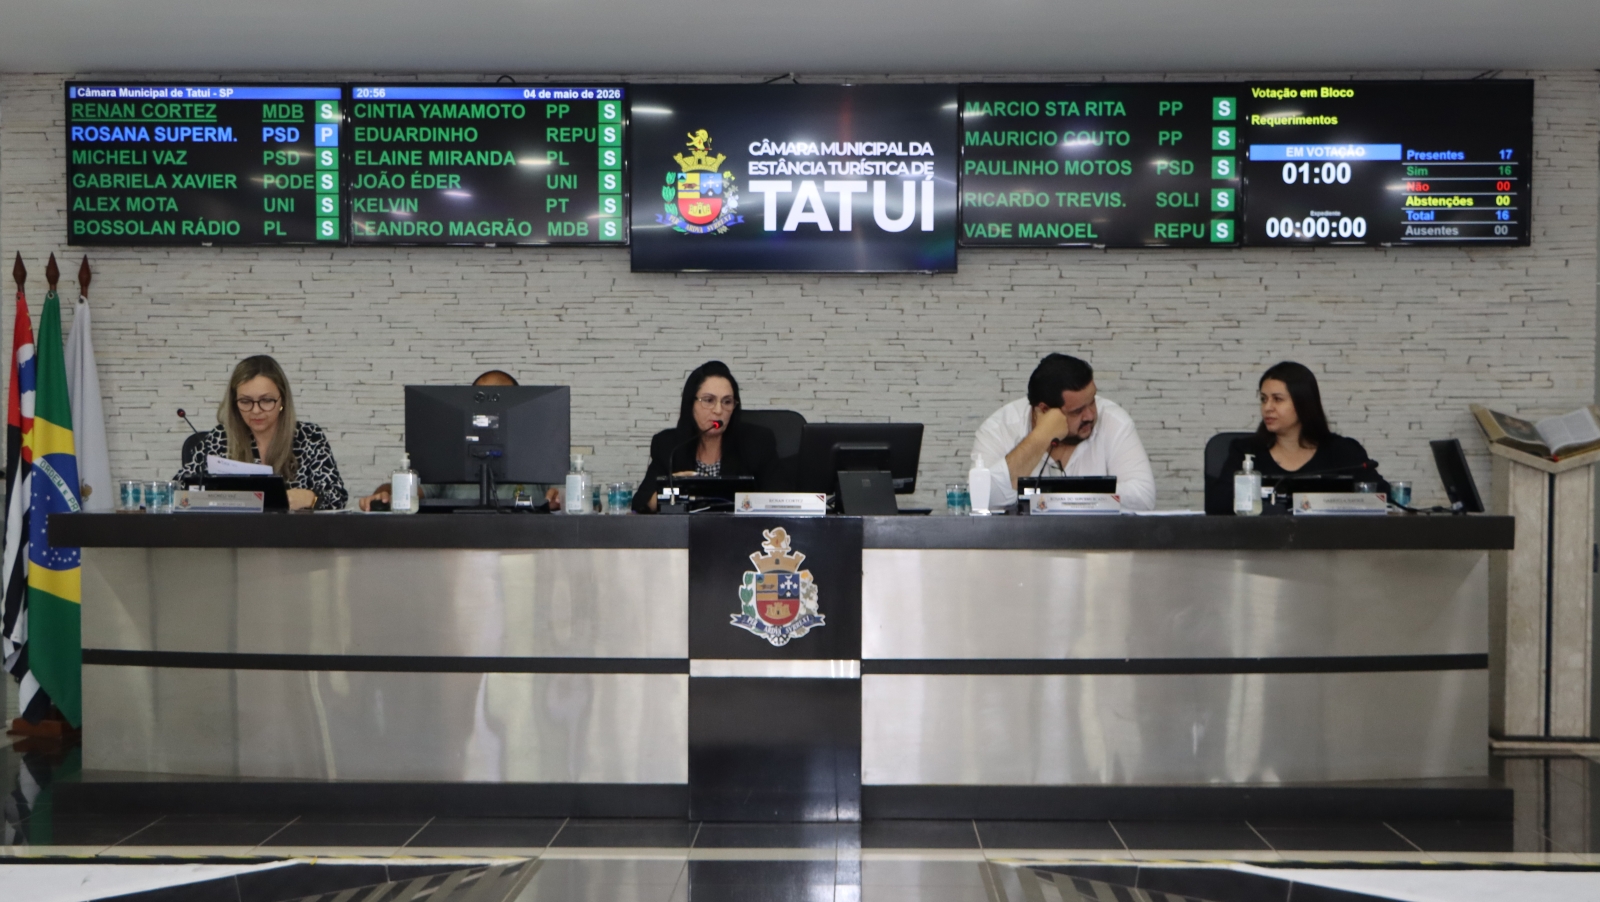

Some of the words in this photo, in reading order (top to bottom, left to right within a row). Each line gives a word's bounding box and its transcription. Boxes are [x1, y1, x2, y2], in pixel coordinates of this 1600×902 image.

[77, 88, 117, 98] Câmara
[119, 88, 168, 99] Municipal
[170, 88, 183, 98] de
[219, 89, 233, 98] SP
[356, 89, 385, 98] 20:56
[524, 90, 536, 98] 04
[539, 89, 551, 98] de
[554, 90, 576, 98] maio
[579, 90, 592, 99] de
[596, 90, 620, 99] 2026
[1251, 88, 1297, 99] Votação
[1300, 89, 1317, 98] em
[1321, 88, 1354, 98] Bloco
[72, 104, 135, 118] RENAN
[141, 104, 217, 118] CORTEZ
[262, 104, 304, 119] MDB
[321, 104, 333, 119] S
[354, 104, 415, 118] CINTIA
[419, 104, 526, 119] YAMAMOTO
[546, 104, 570, 118] PP
[604, 104, 616, 119] S
[965, 102, 1040, 116] MARCIO
[1045, 102, 1080, 116] STA
[1085, 102, 1126, 116] RITA
[1159, 102, 1183, 115] PP
[1218, 101, 1230, 116] S
[1251, 115, 1337, 126] Requerimentos
[72, 127, 150, 141] ROSANA
[155, 127, 237, 141] SUPERM.
[262, 128, 299, 142] PSD
[321, 128, 333, 142] P
[355, 127, 478, 142] EDUARDINHO
[546, 128, 595, 142] REPU
[604, 128, 616, 142] S
[965, 132, 1057, 146] MAURICIO
[1063, 131, 1130, 146] COUTO
[1159, 132, 1182, 145] PP
[1218, 130, 1230, 145] S
[749, 138, 820, 156] CÂMARA
[821, 142, 908, 156] MUNICIPAL
[909, 142, 934, 156] DA
[1286, 147, 1303, 157] EM
[1306, 145, 1365, 159] VOTAÇÃO
[72, 151, 147, 165] MICHELI
[153, 151, 187, 165] VAZ
[263, 151, 300, 165] PSD
[321, 151, 333, 166] S
[355, 151, 422, 165] ELAINE
[429, 151, 516, 165] MIRANDA
[547, 151, 569, 165] PL
[604, 151, 616, 166] S
[1407, 150, 1465, 160] Presentes
[1500, 150, 1512, 160] 17
[749, 158, 826, 175] ESTÂNCIA
[828, 157, 907, 175] TURÍSTICA
[911, 162, 934, 175] DE
[965, 161, 1059, 175] PAULINHO
[1065, 160, 1132, 175] MOTOS
[1157, 161, 1194, 175] PSD
[1217, 160, 1229, 175] S
[1282, 163, 1351, 184] 01:00
[1407, 167, 1428, 175] Sim
[1499, 167, 1512, 175] 16
[72, 174, 167, 188] GABRIELA
[172, 174, 237, 188] XAVIER
[263, 175, 314, 189] PODE
[321, 175, 333, 189] S
[354, 171, 405, 189] JOÃO
[411, 171, 461, 189] ÉDER
[547, 175, 577, 189] UNI
[604, 175, 616, 189] S
[1406, 182, 1429, 191] Não
[1497, 182, 1510, 191] 00
[73, 197, 120, 212] ALEX
[127, 197, 178, 212] MOTA
[264, 198, 294, 212] UNI
[322, 198, 333, 212] S
[354, 198, 418, 212] KELVIN
[546, 198, 569, 212] PT
[604, 198, 616, 213] S
[749, 173, 934, 232] TATUÍ
[965, 193, 1050, 207] RICARDO
[1055, 193, 1126, 207] TREVIS.
[1156, 193, 1198, 207] SOLI
[1217, 192, 1229, 207] S
[1405, 197, 1473, 208] Abstenções
[1496, 197, 1510, 205] 00
[1406, 211, 1434, 221] Total
[1496, 211, 1509, 220] 16
[74, 221, 176, 235] BOSSOLAN
[182, 217, 240, 235] RÁDIO
[264, 221, 287, 235] PL
[322, 221, 334, 235] S
[354, 221, 443, 236] LEANDRO
[449, 218, 532, 236] MAGRÃO
[548, 222, 588, 236] MDB
[604, 222, 616, 236] S
[964, 224, 1012, 238] VADE
[1018, 224, 1098, 238] MANOEL
[1154, 224, 1204, 238] REPU
[1216, 223, 1228, 238] S
[1266, 217, 1366, 238] 00:00:00
[1405, 226, 1458, 236] Ausentes
[1495, 226, 1508, 235] 00
[40, 460, 64, 488] ORDEM
